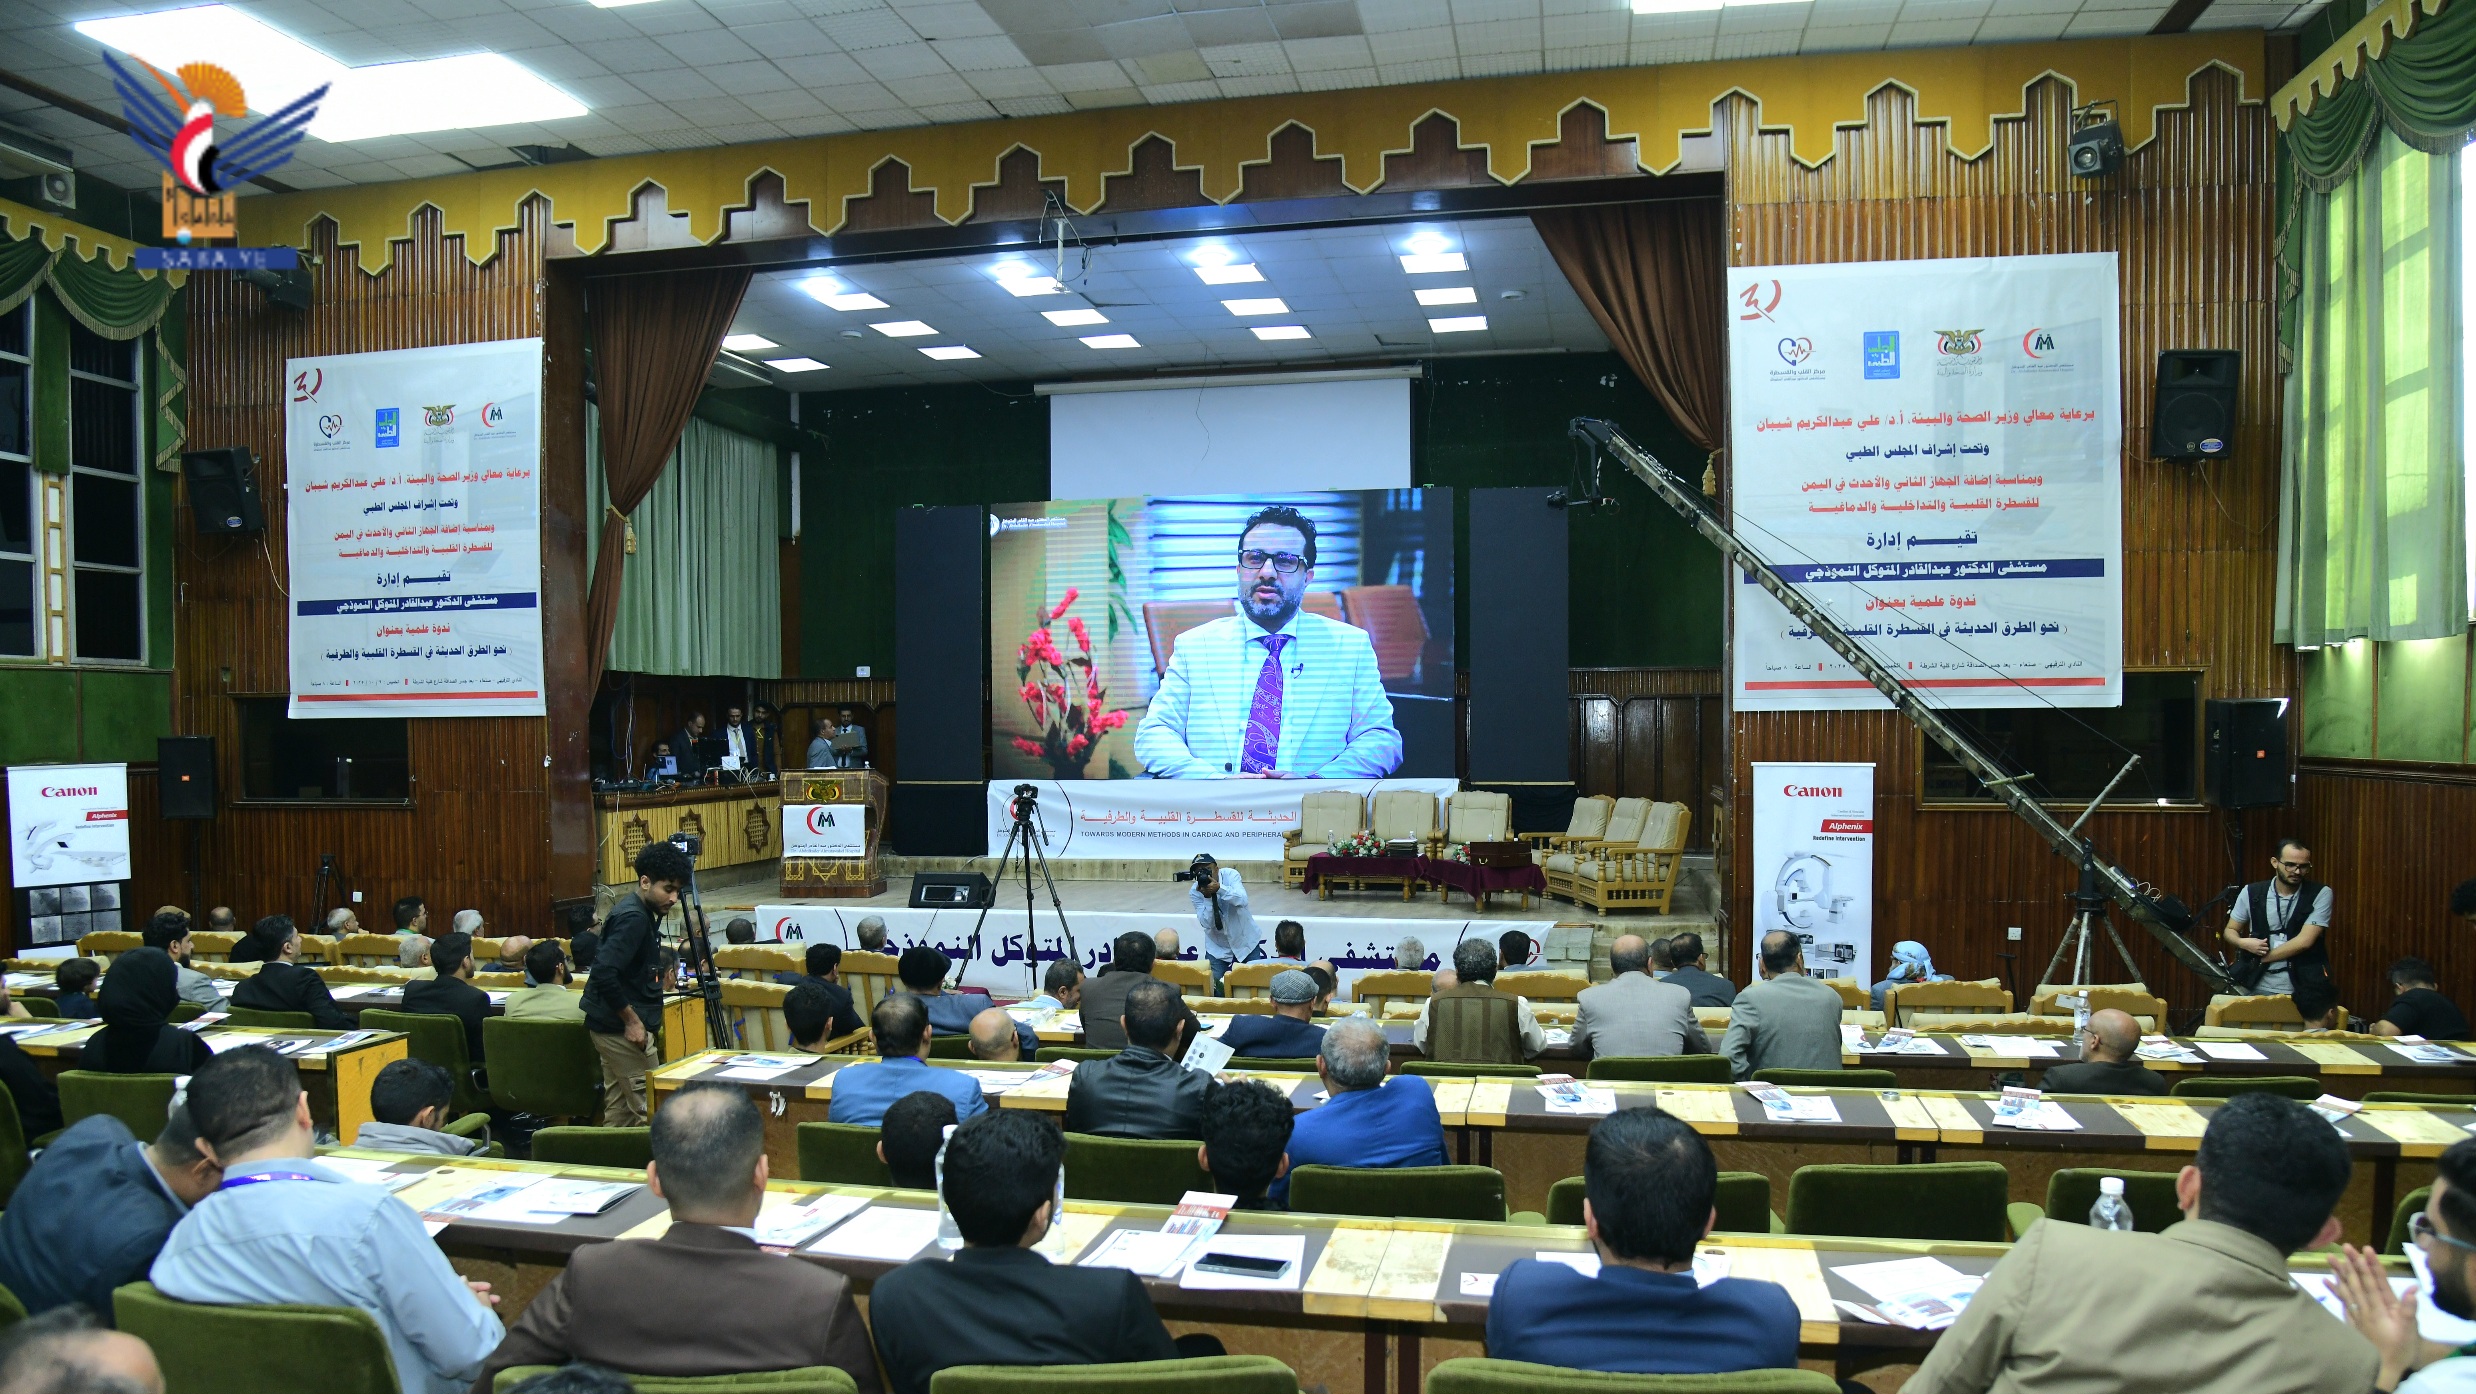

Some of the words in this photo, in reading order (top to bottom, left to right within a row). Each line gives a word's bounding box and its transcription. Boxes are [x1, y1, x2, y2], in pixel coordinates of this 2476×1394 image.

[1957, 411, 1990, 422] الصحة
[1995, 411, 2019, 424] وزير
[2024, 410, 2054, 423] معالي
[2060, 408, 2094, 422] برعاية
[1757, 417, 1792, 432] شيبان
[1797, 416, 1852, 431] عبدالكريم
[1858, 415, 1879, 431] علي
[1846, 446, 1879, 462] الطبي
[1884, 444, 1917, 458] المجلس
[1922, 443, 1955, 457] إشراف
[1960, 443, 1989, 455] وتحت
[437, 472, 459, 481] الصحة
[462, 471, 478, 482] وزير
[481, 470, 502, 483] معالي
[507, 468, 530, 478] برعاية
[306, 480, 328, 492] شيبان
[332, 479, 367, 491] عبدالكريم
[371, 477, 385, 488] علي
[1802, 479, 1831, 492] اليمن
[1836, 478, 1845, 493] في
[1849, 477, 1890, 489] والأحدث
[1894, 476, 1925, 489] الثاني
[1930, 476, 1959, 488] الجهاز
[1964, 475, 1991, 488] إضافة
[1996, 474, 2042, 487] وبمناسبة
[364, 502, 385, 516] الطبي
[389, 501, 410, 512] المجلس
[414, 499, 436, 510] إشراف
[439, 499, 458, 508] وتحت
[1809, 501, 1876, 514] والدماغية
[1881, 500, 1945, 513] والتداخلية
[1950, 498, 1991, 511] القلبية
[1996, 498, 2039, 510] للقسطرة
[366, 528, 392, 538] والأحدث
[396, 527, 416, 538] الثاني
[419, 526, 438, 536] الجهاز
[441, 525, 460, 533] إضافة
[463, 523, 494, 534] وبمناسبة
[335, 530, 353, 541] اليمن
[357, 532, 363, 540] في
[1867, 532, 1900, 550] إدارة
[339, 548, 383, 559] والدماغية
[386, 546, 429, 555] والتداخلية
[432, 544, 460, 555] القلبية
[463, 543, 492, 553] للقسطرة
[1806, 565, 1860, 582] النموذجي
[1863, 564, 1900, 579] المتوكل
[1903, 564, 1951, 577] عبدالقادر
[1955, 561, 1994, 576] الدكتور
[1998, 562, 2047, 575] مستشفى
[377, 572, 399, 587] إدارة
[375, 599, 399, 612] المتوكل
[436, 596, 462, 608] الدكتور
[464, 595, 498, 606] مستشفى
[1866, 596, 1906, 612] بعنوان
[1911, 596, 1944, 609] علمية
[1950, 594, 1975, 609] ندوة
[336, 601, 372, 614] النموذجي
[377, 626, 403, 637] بعنوان
[406, 625, 429, 636] علمية
[433, 623, 450, 635] ندوة
[1887, 622, 1935, 636] القسطرة
[1938, 622, 1950, 637] في
[1955, 622, 1997, 636] الحديثة
[2002, 621, 2035, 636] الطرق
[2040, 622, 2059, 635] نحو
[326, 649, 358, 661] والطرفية
[362, 648, 387, 660] القلبية
[391, 647, 422, 659] القسطرة
[426, 646, 433, 660] في
[436, 646, 464, 655] الحديثة
[468, 645, 490, 657] الطرق
[494, 645, 506, 656] نحو
[41, 786, 98, 798] Canon
[1783, 784, 1843, 798] Canon
[91, 812, 118, 820] Alphenix
[1080, 809, 1136, 825] والطرفية
[1140, 809, 1182, 825] القلبية
[1187, 811, 1243, 825] للقسطرة
[1248, 810, 1297, 825] الحديثة
[1828, 822, 1864, 832] Alphenix
